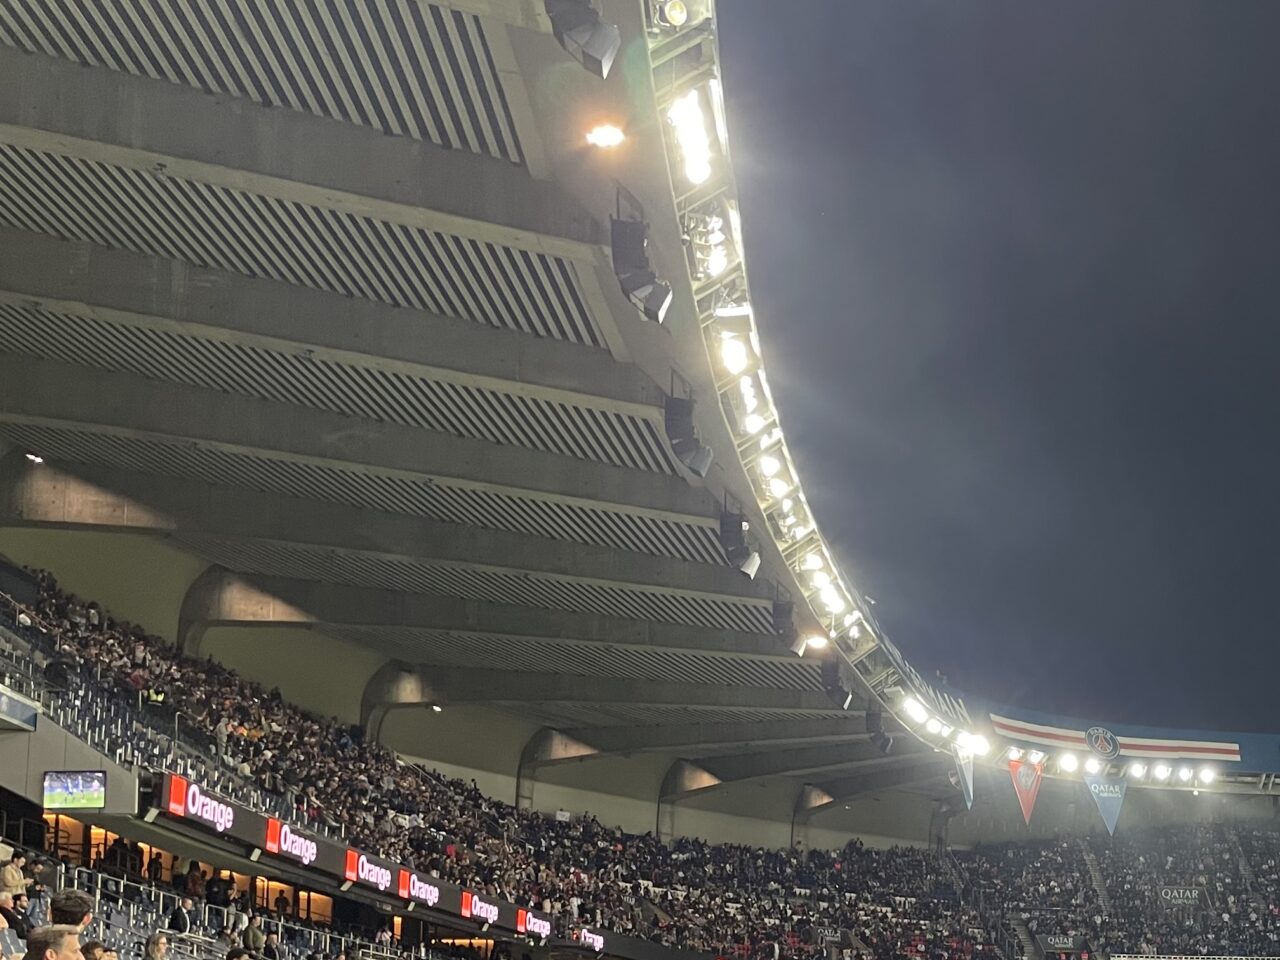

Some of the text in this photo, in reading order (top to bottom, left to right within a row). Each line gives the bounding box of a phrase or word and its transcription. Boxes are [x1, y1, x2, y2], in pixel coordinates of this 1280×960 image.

[1091, 783, 1121, 794] QATAR
[188, 783, 234, 832] Orange
[280, 824, 318, 865] Orange
[357, 854, 392, 890] Orange
[409, 875, 440, 907] Orange
[1161, 888, 1199, 900] QATAR
[471, 895, 499, 923] Orange
[525, 911, 551, 936] Orange
[1047, 936, 1074, 945] QATAR
